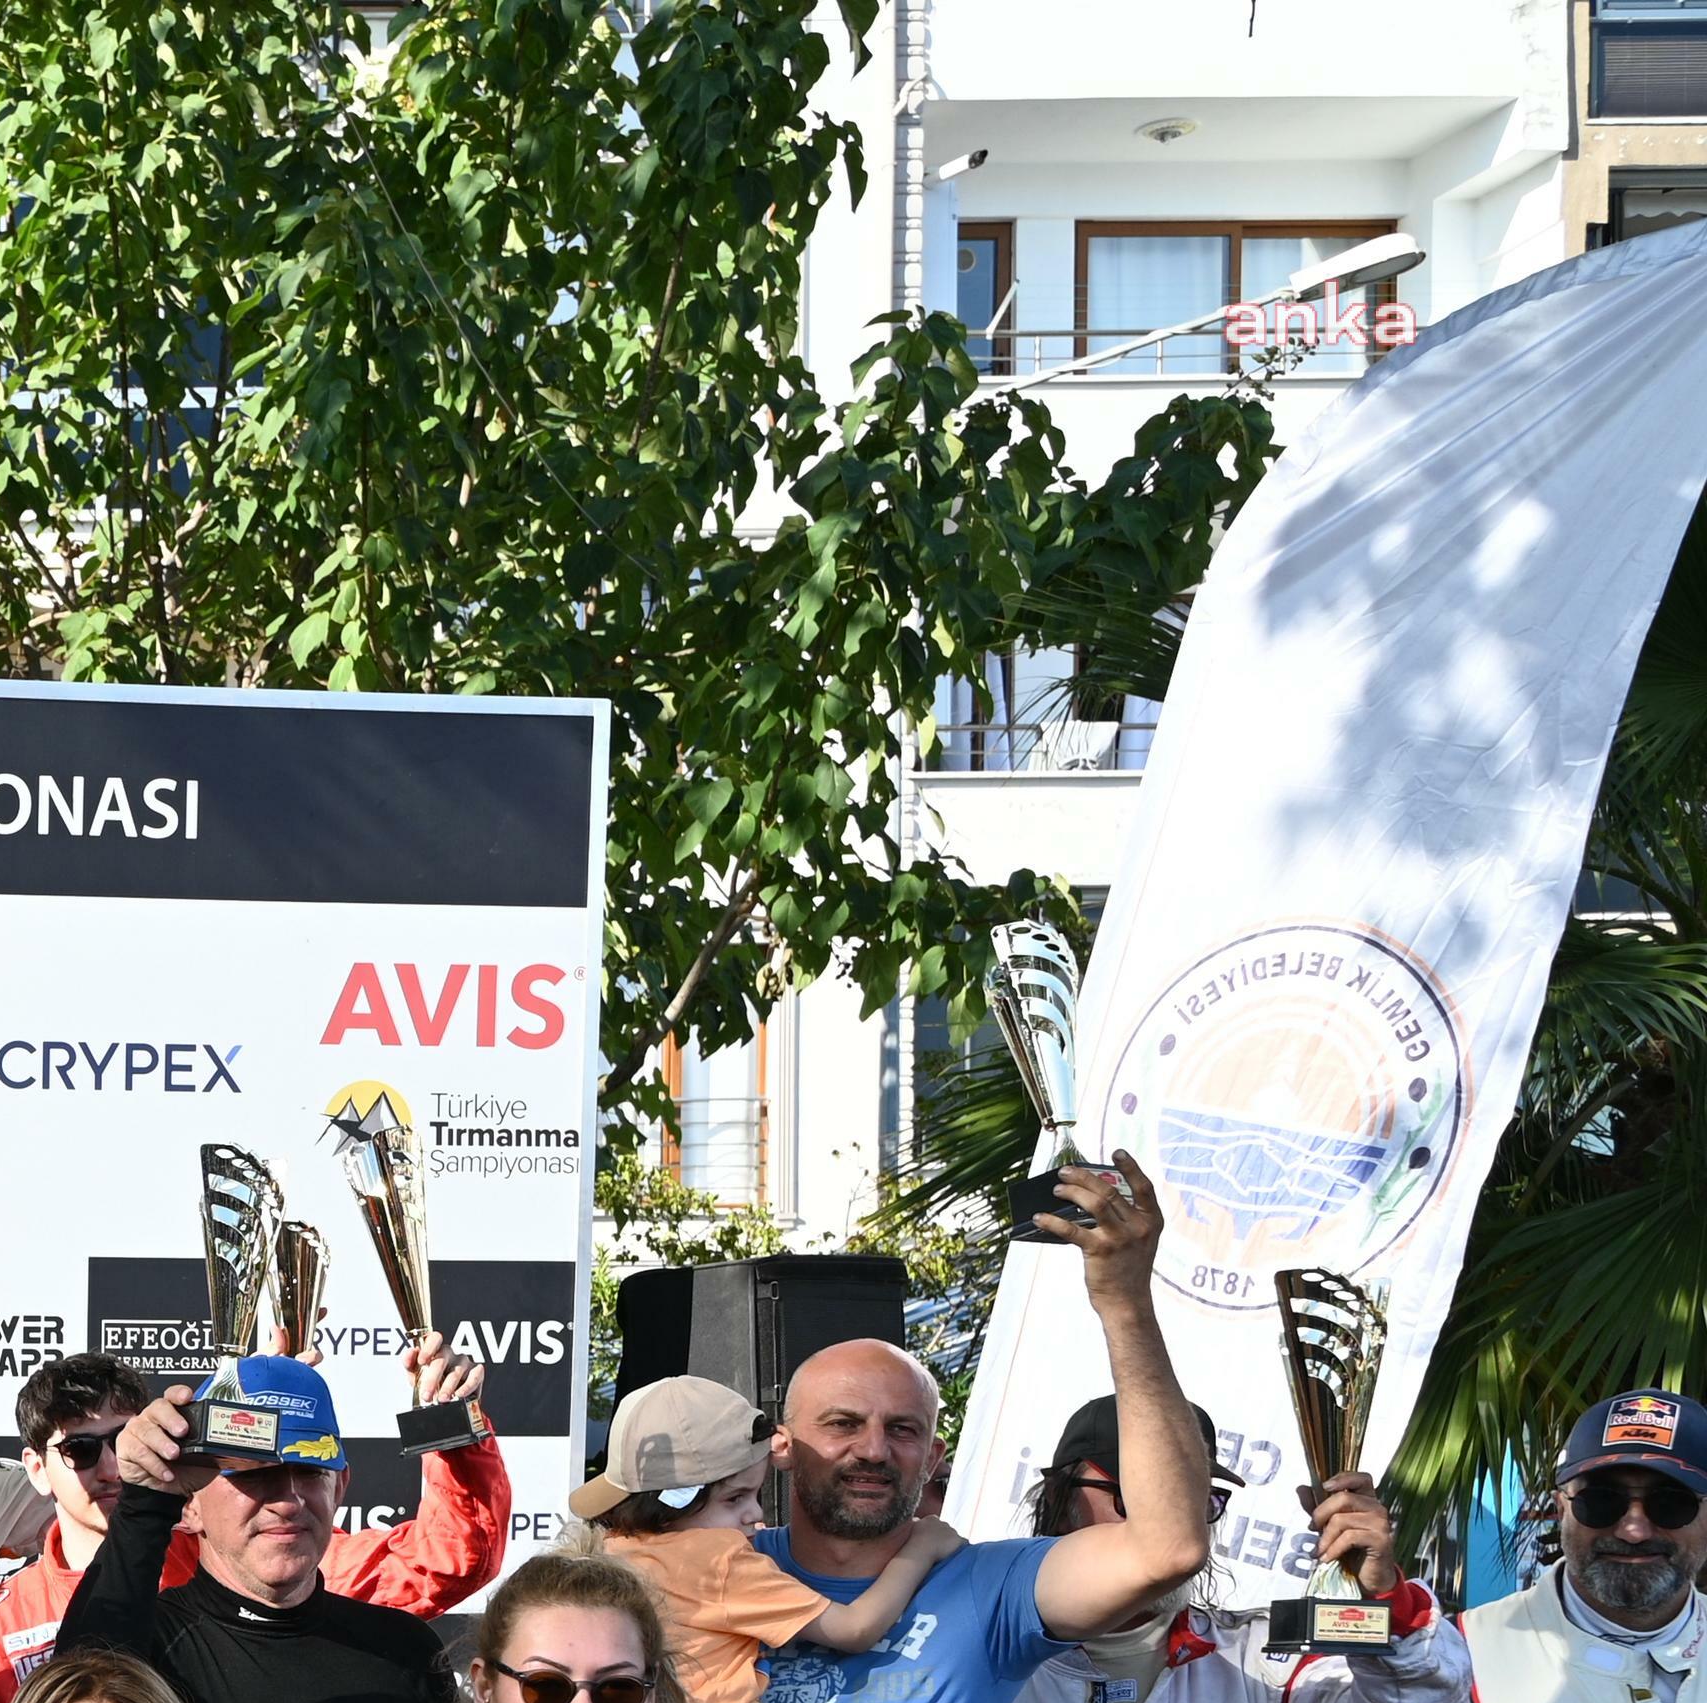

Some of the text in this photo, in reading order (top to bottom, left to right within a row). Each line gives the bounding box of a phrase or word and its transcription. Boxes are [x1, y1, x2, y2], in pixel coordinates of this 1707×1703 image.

[319, 962, 567, 1050] AVIS
[431, 1092, 527, 1122] Türkiye
[430, 1122, 580, 1148] Tırmanma
[429, 1150, 580, 1179] Şampiyonası
[105, 1321, 215, 1350] EFEOĞL
[313, 1328, 413, 1356] RYPEX
[450, 1320, 564, 1365] AVIS
[117, 1356, 221, 1370] ERMER-GRAN
